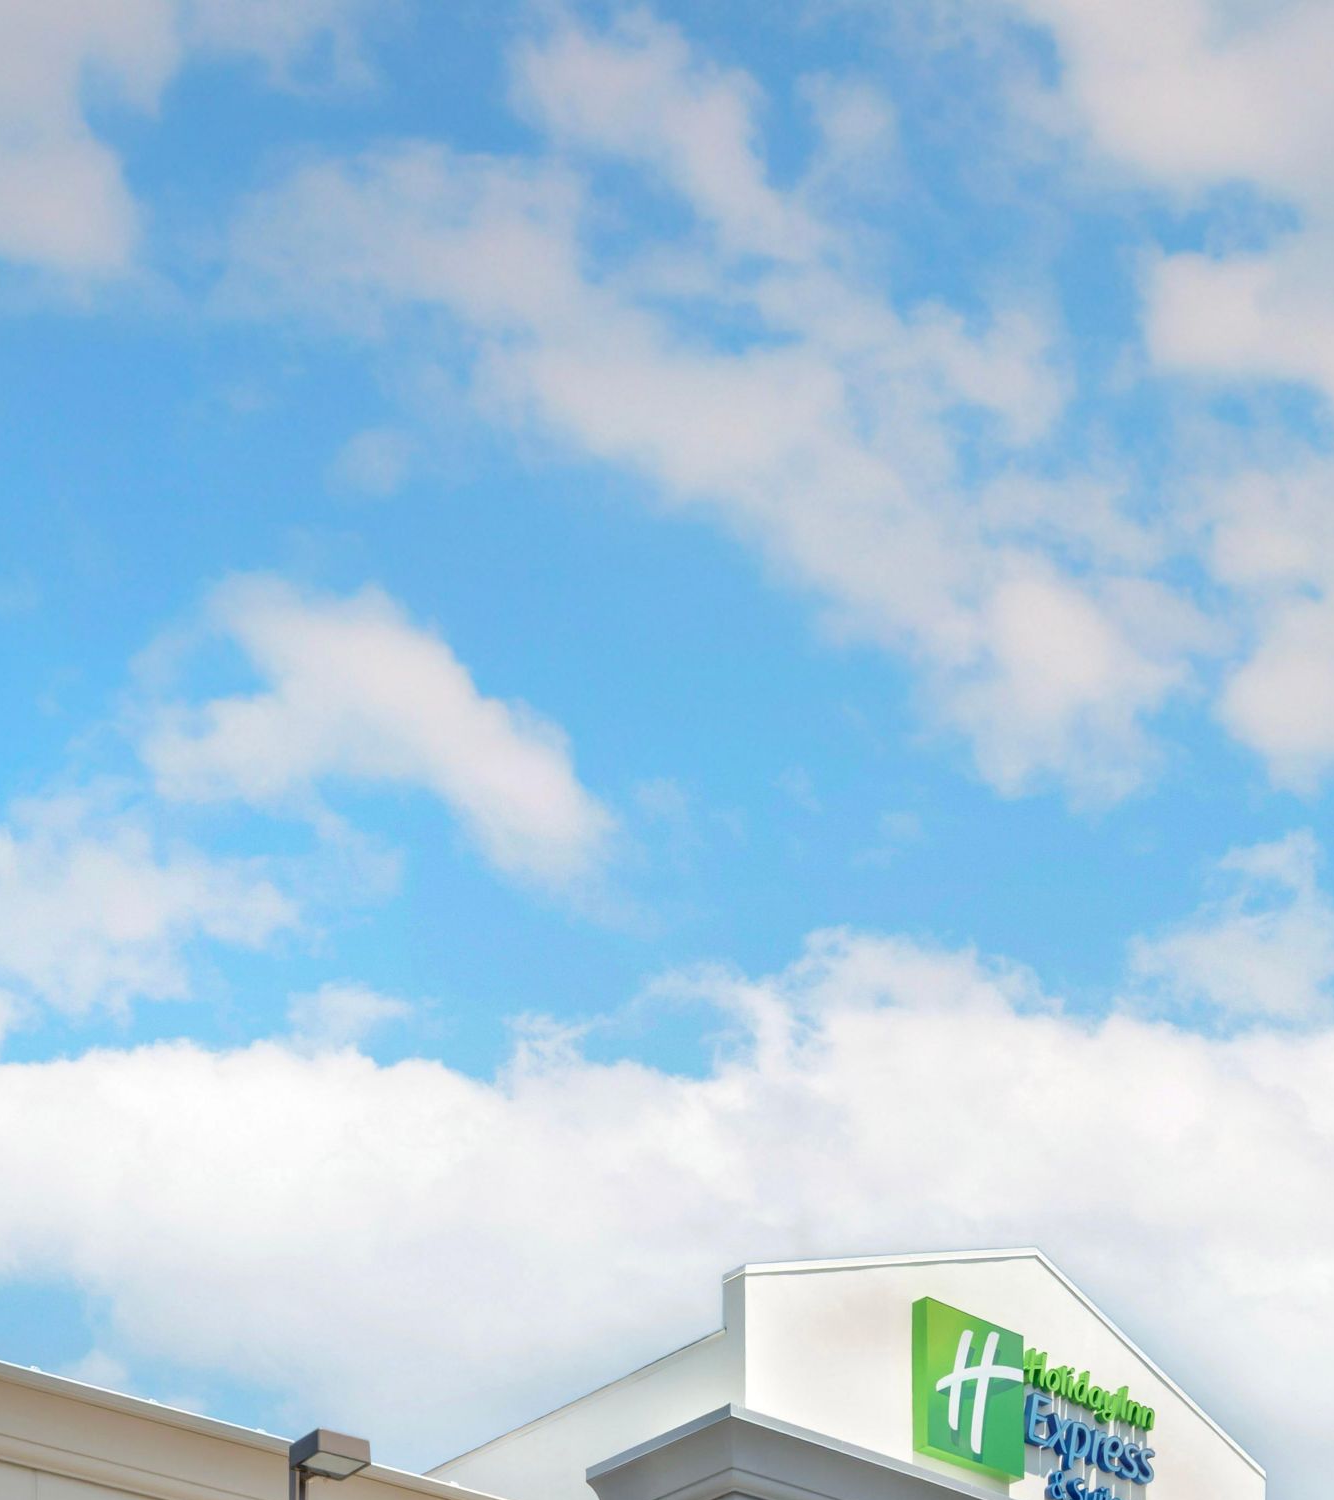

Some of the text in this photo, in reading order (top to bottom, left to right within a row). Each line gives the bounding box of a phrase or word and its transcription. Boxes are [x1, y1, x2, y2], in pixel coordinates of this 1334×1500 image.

[1024, 1348, 1156, 1432] Holiday Inn
[1024, 1392, 1156, 1486] Express
